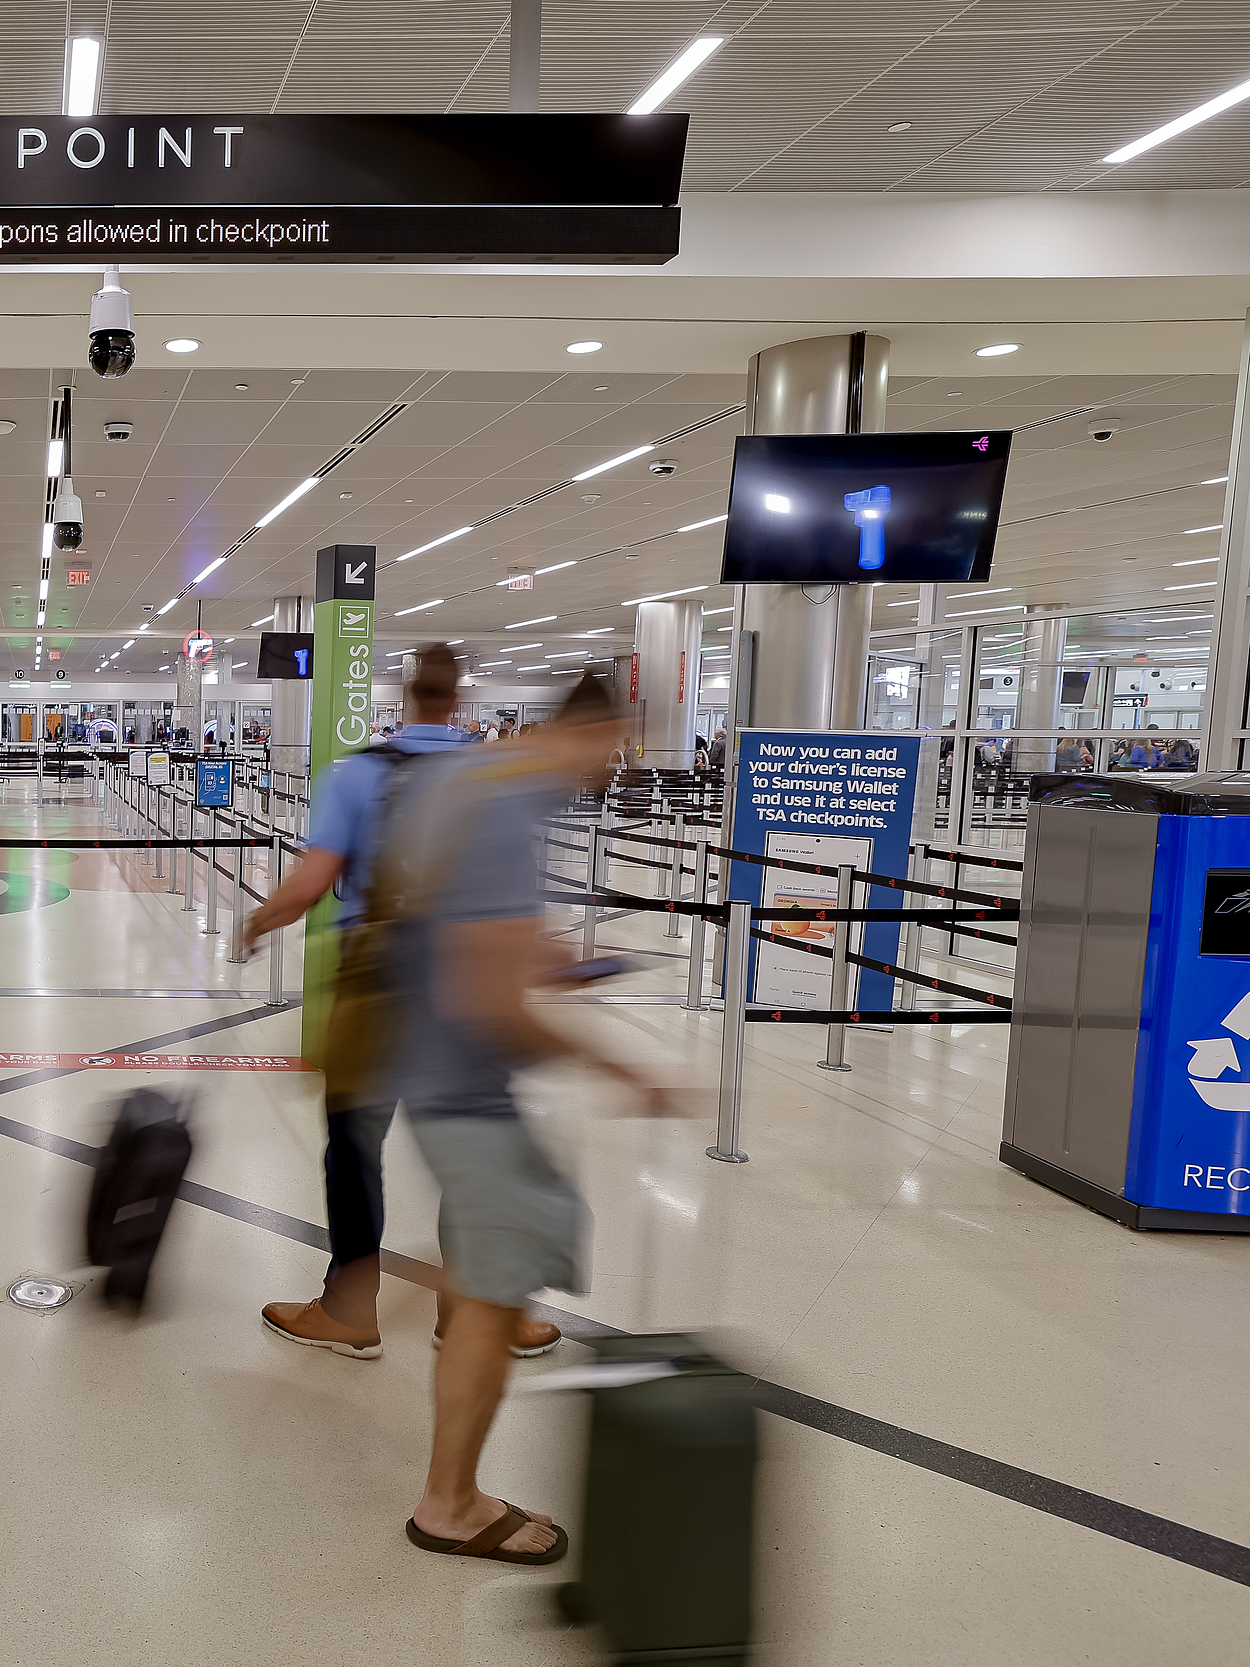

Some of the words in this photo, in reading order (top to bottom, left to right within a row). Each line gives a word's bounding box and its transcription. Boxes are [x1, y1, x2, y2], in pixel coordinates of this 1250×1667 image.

[66, 218, 161, 243] allowed
[169, 218, 187, 243] in
[195, 218, 330, 248] checkpoint
[68, 571, 89, 585] EXIT
[336, 644, 370, 746] Gates
[759, 743, 796, 757] Now
[799, 746, 830, 760] you
[832, 748, 862, 760] can
[864, 747, 898, 761] add
[748, 761, 786, 774] your
[787, 760, 848, 776] driver’s
[850, 763, 907, 779] license
[752, 775, 769, 789] to
[771, 776, 844, 795] Samsung
[846, 780, 900, 796] Wallet
[751, 792, 781, 806] and
[784, 795, 812, 808] use
[814, 794, 827, 809] it
[829, 796, 847, 809] at
[849, 797, 897, 813] select
[756, 807, 787, 822] TSA
[789, 810, 889, 829] checkpoints.
[167, 1056, 288, 1064] FIREARMS
[1183, 1164, 1250, 1192] REC
